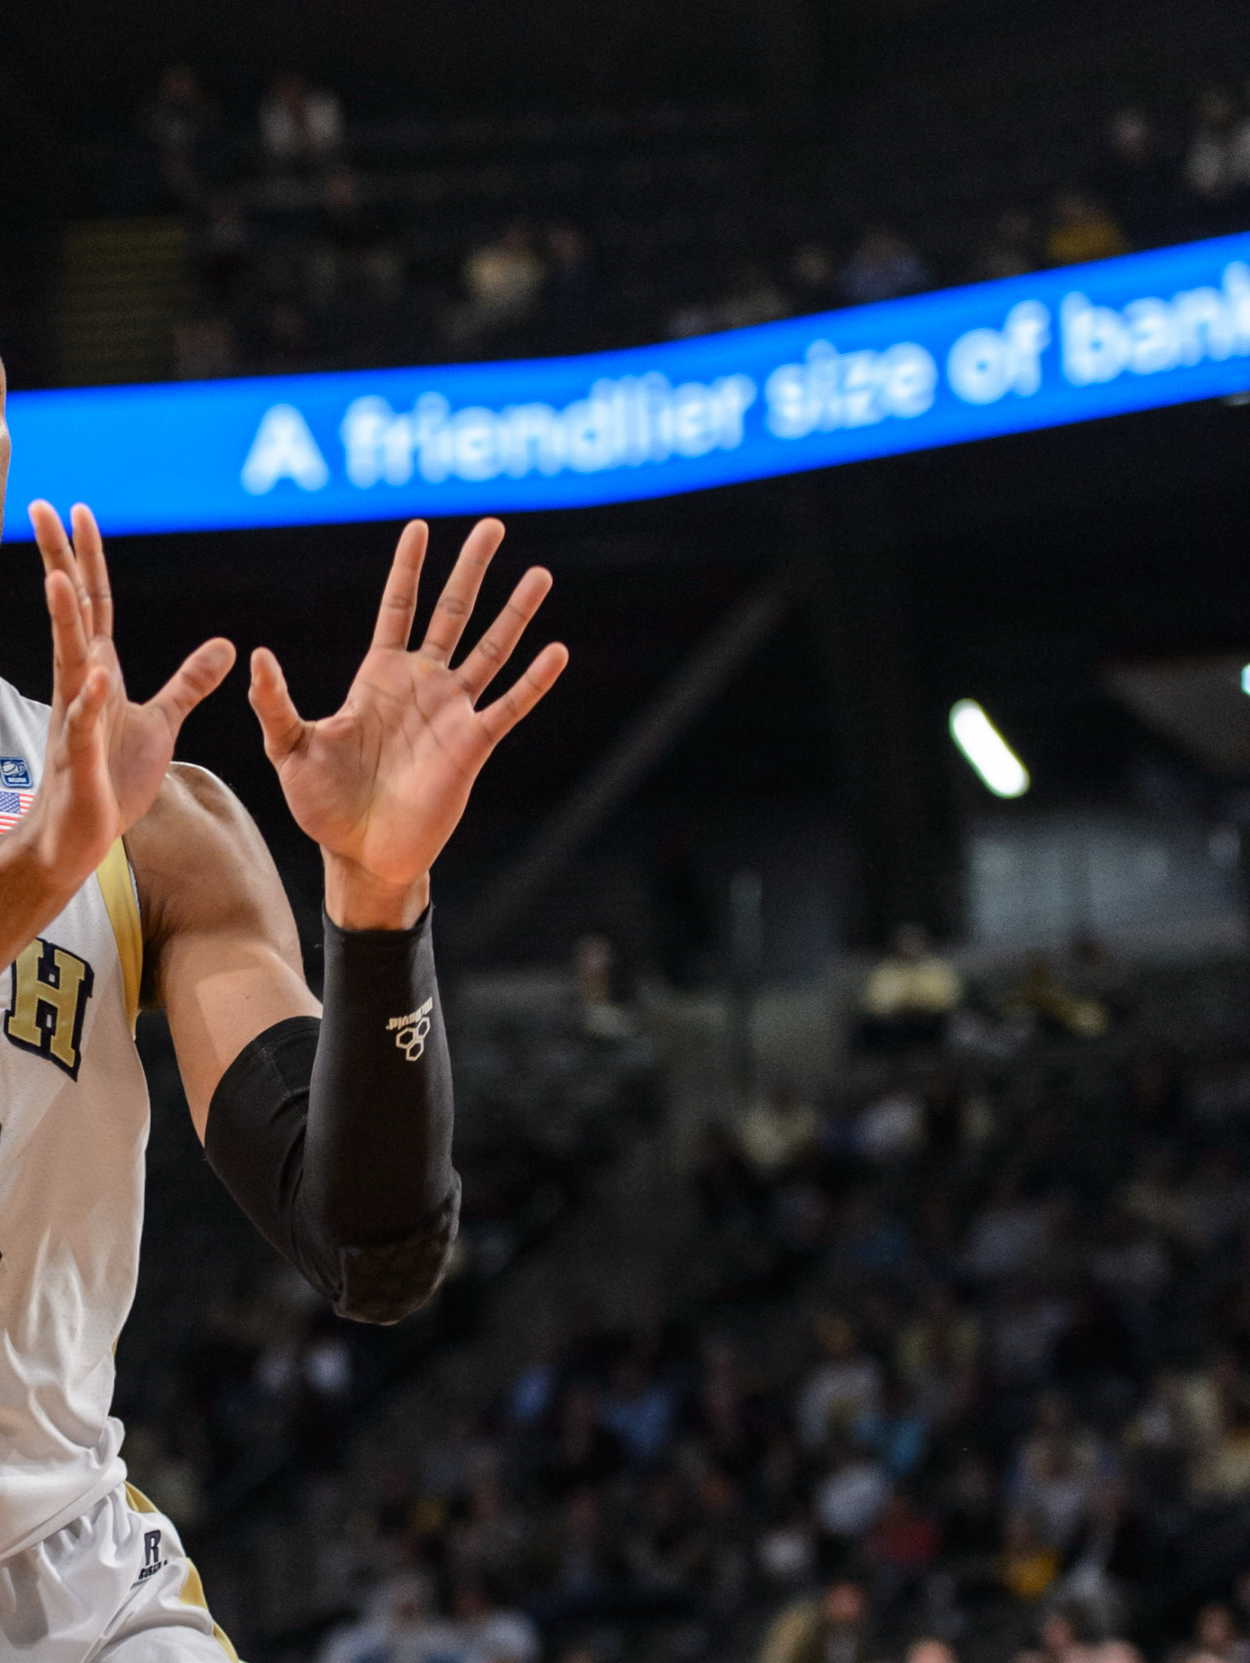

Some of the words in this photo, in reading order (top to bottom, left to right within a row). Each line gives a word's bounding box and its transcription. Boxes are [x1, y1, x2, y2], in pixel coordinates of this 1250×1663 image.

[242, 403, 330, 496] A
[340, 371, 756, 488] friendlier
[764, 338, 938, 439] size
[947, 299, 1051, 405] of
